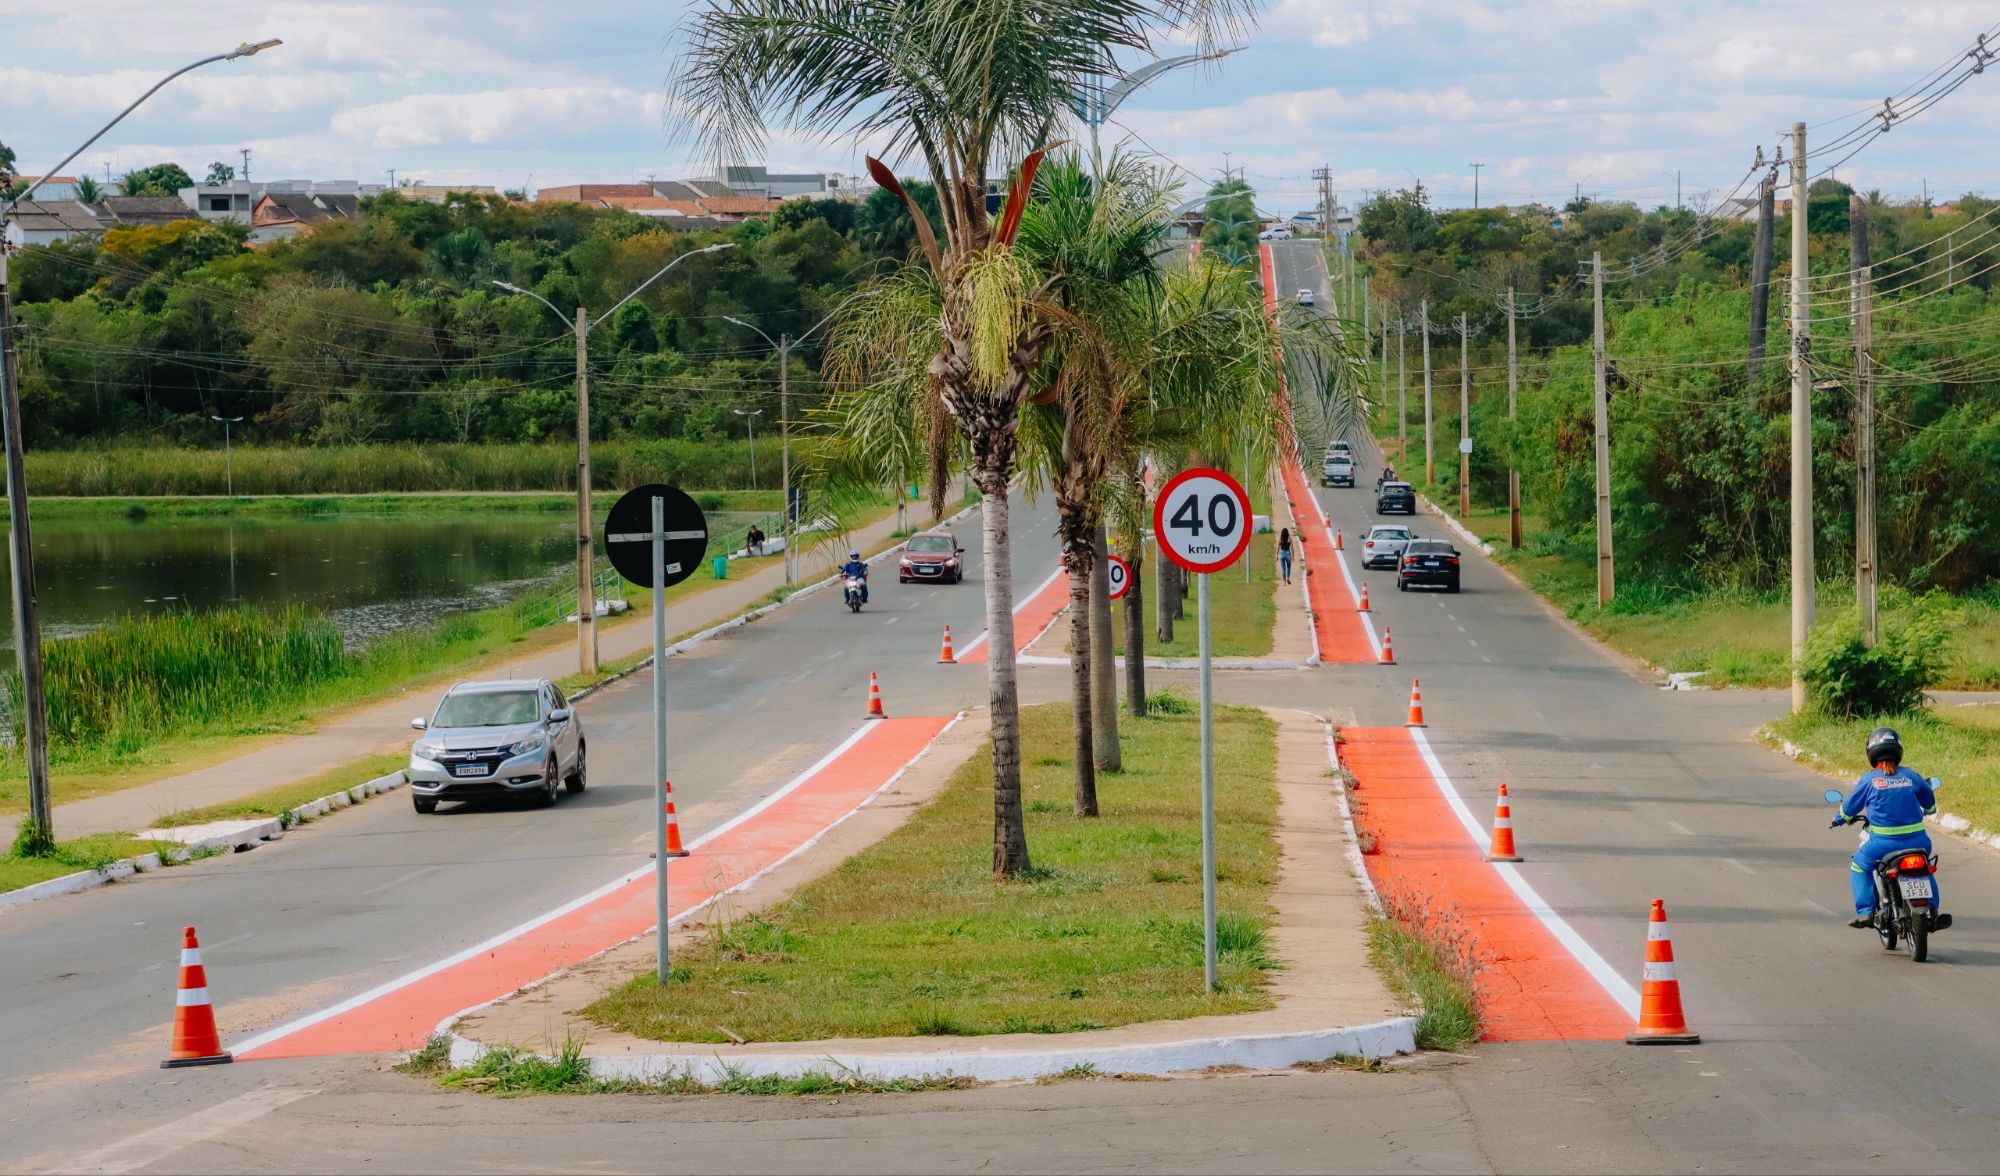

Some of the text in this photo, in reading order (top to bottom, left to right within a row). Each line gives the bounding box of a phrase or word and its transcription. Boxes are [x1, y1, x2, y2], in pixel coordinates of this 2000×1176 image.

[1170, 493, 1237, 537] 40
[1188, 544, 1221, 554] km/h
[1110, 565, 1124, 584] 0
